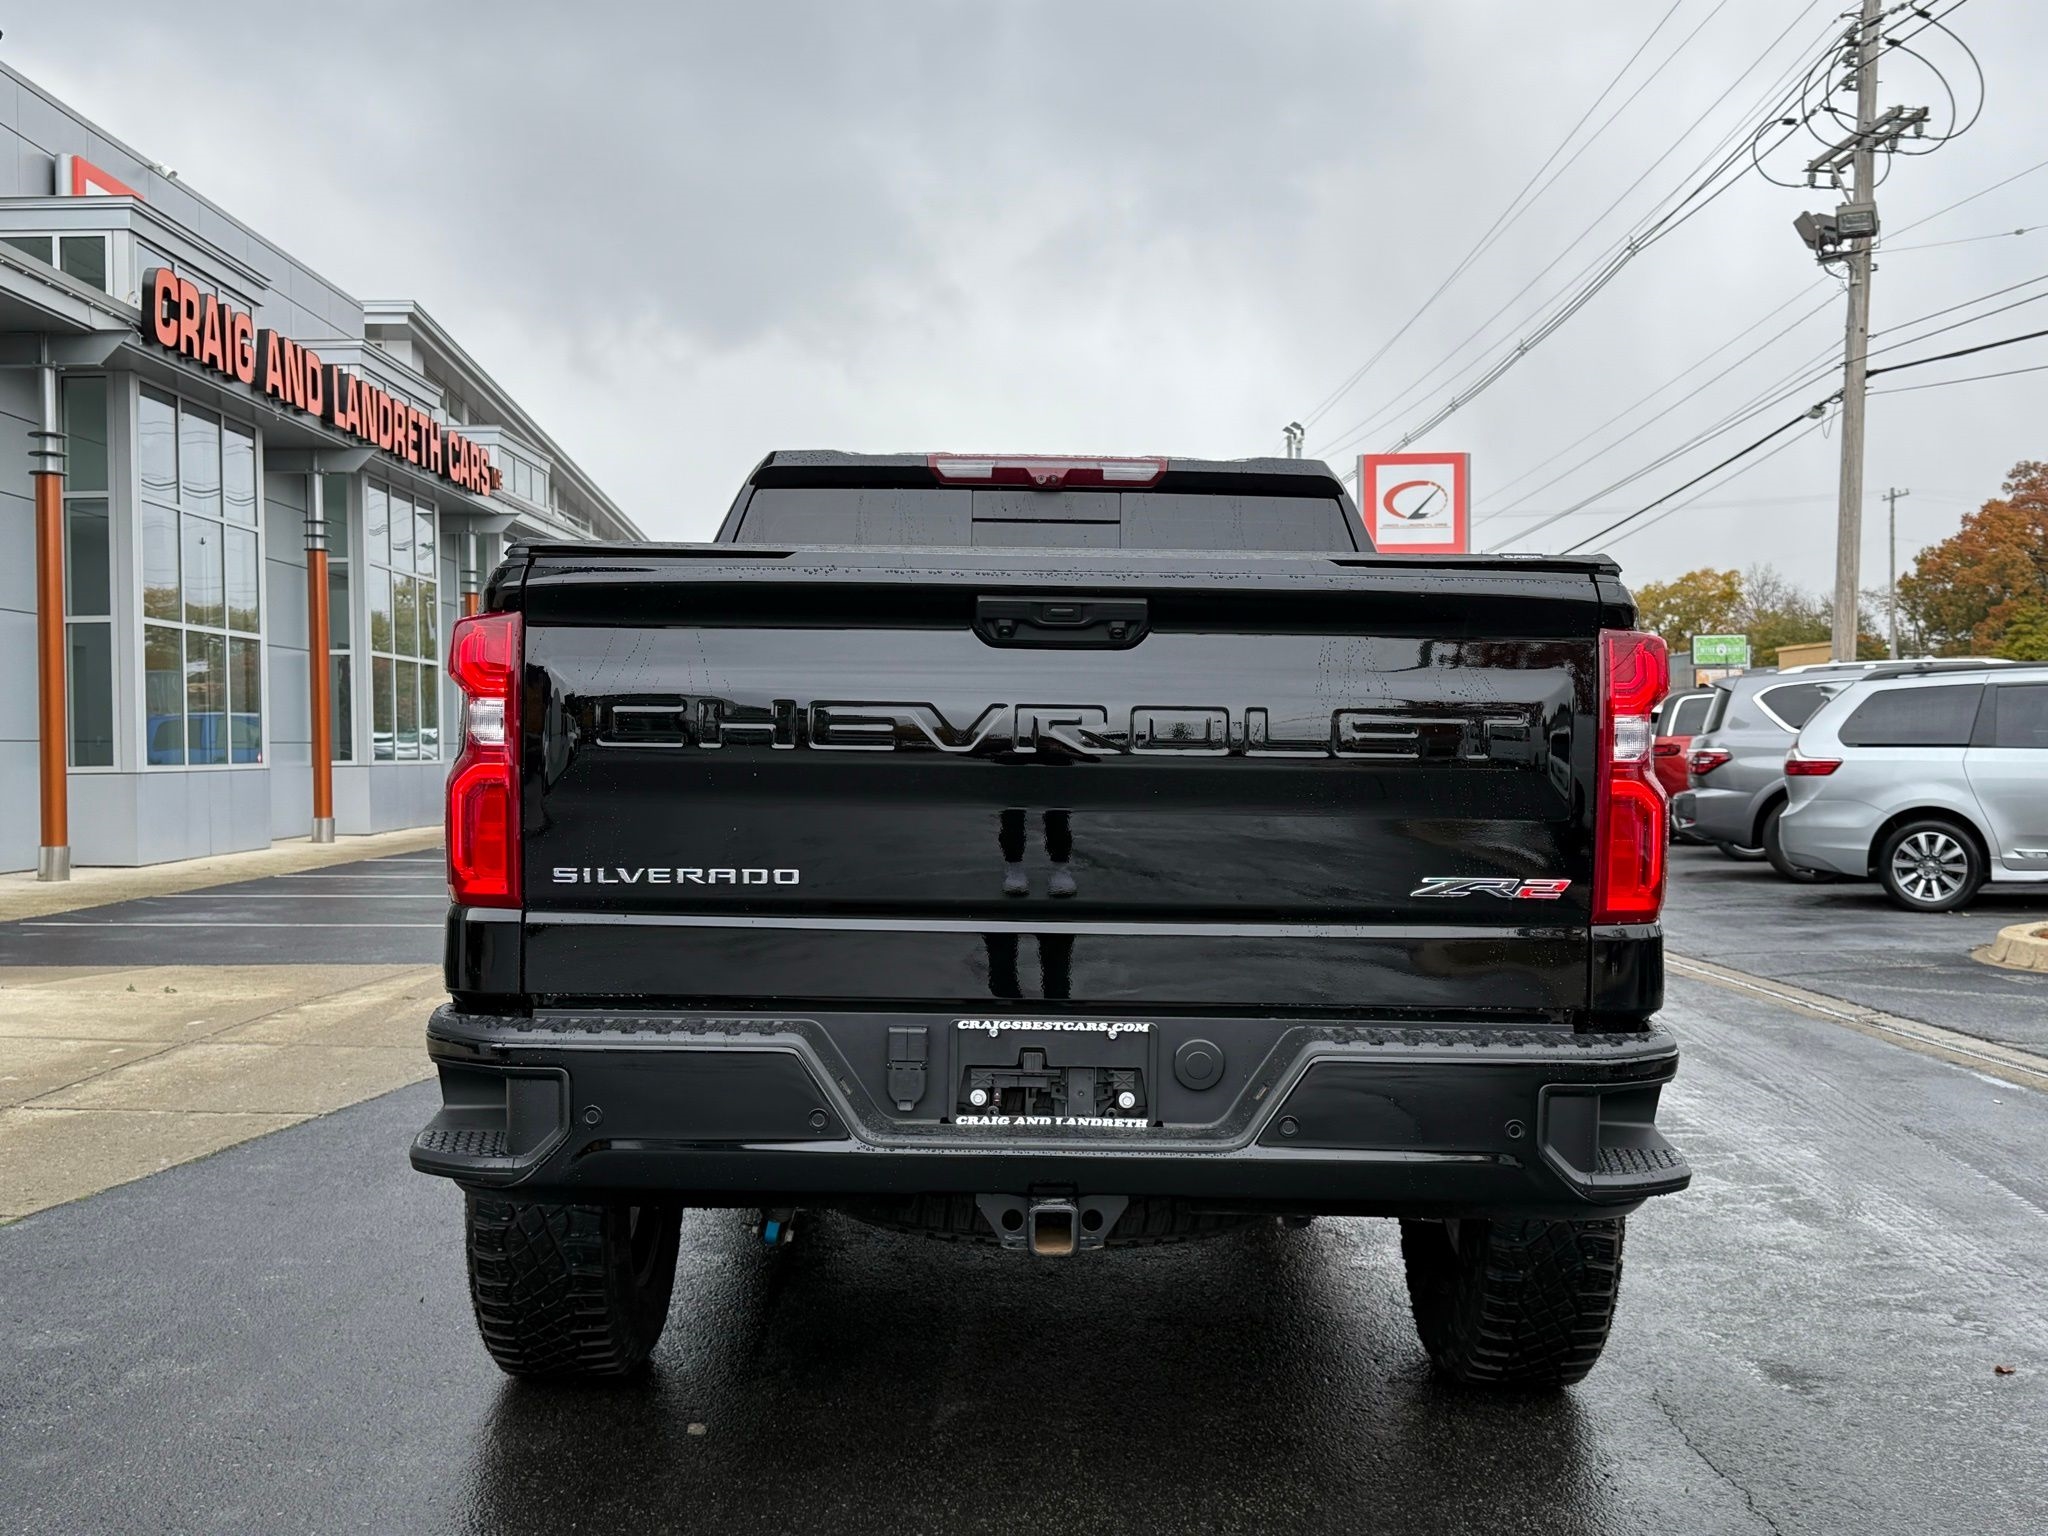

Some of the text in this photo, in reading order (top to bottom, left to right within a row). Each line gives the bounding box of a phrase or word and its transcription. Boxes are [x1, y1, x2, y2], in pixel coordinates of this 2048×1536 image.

[153, 267, 254, 384] CRAIG
[264, 328, 323, 417] AND
[332, 364, 443, 475] LANDRETH
[447, 430, 490, 497] CARS
[595, 699, 1530, 760] CHEVROLET
[552, 867, 800, 885] SILVERADO
[1409, 876, 1573, 900] ZR2
[957, 1020, 1150, 1033] CRAIGSBESTCARS.COM
[955, 1116, 1148, 1128] CRAIG AND LANDRETH
